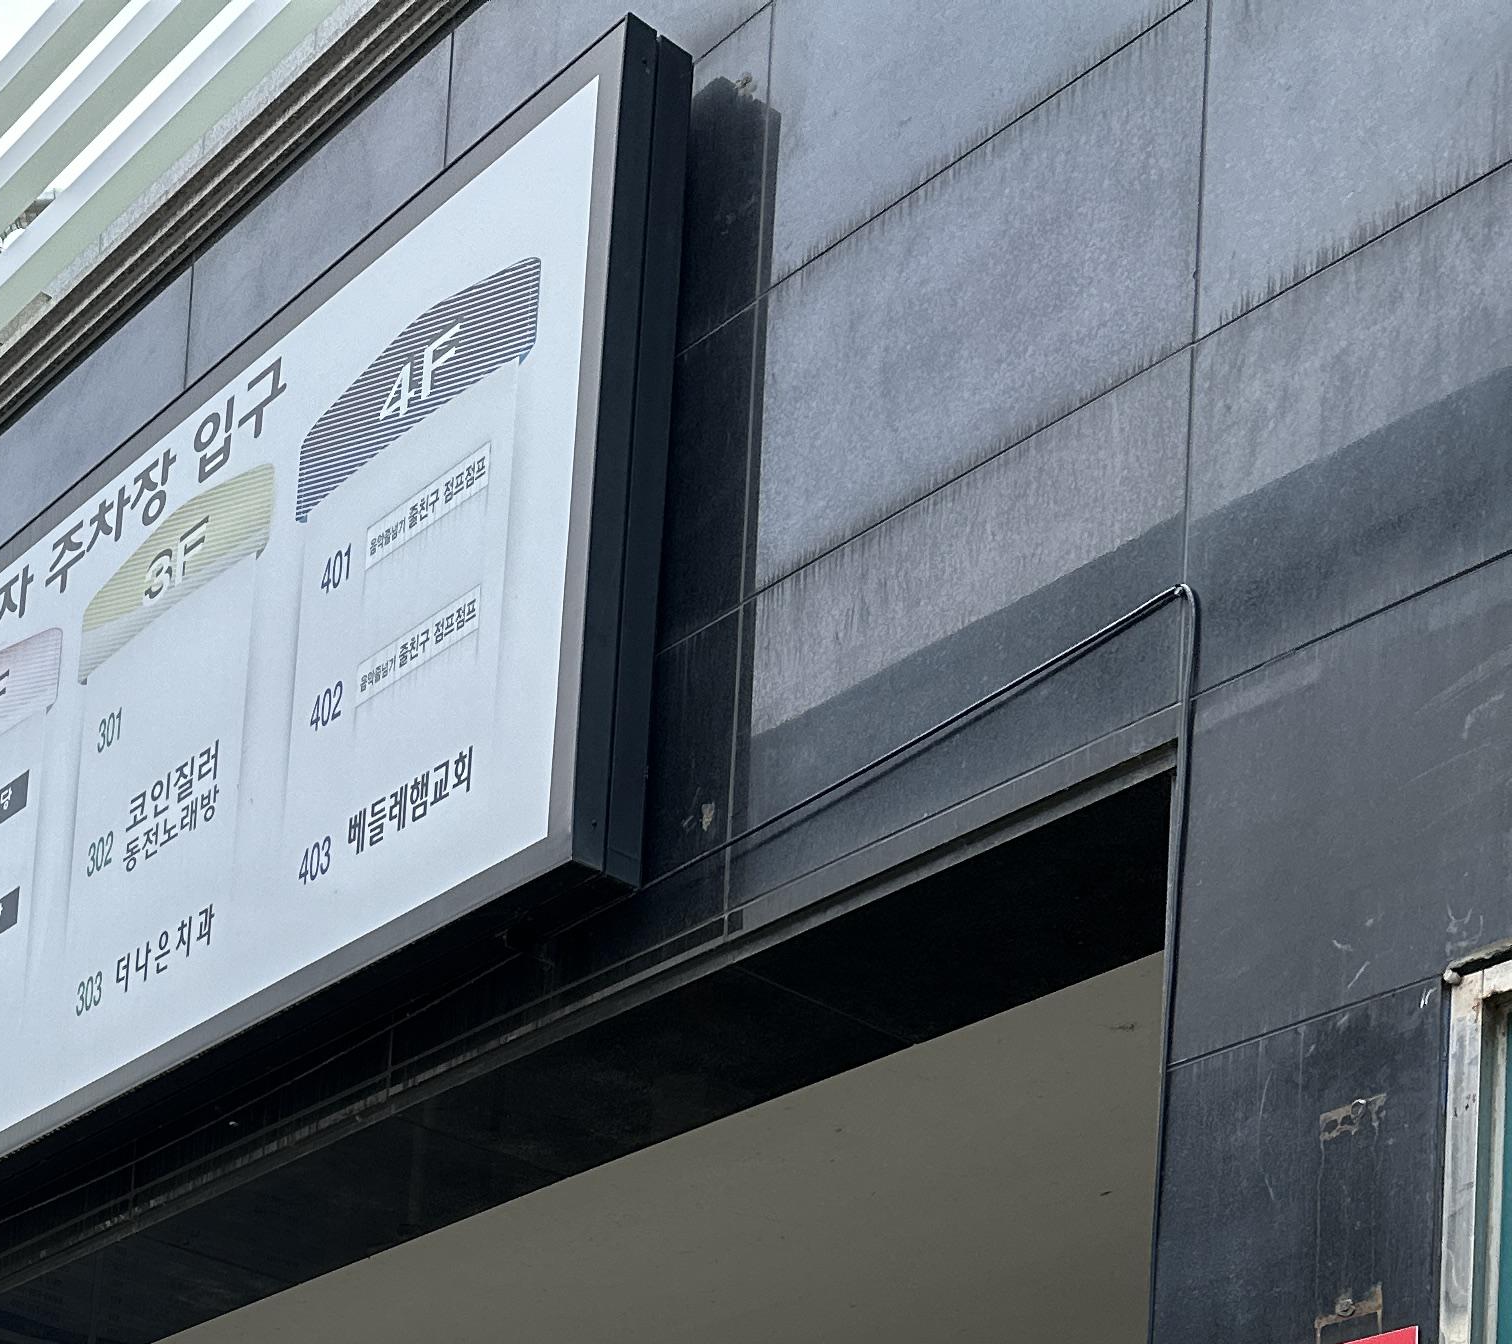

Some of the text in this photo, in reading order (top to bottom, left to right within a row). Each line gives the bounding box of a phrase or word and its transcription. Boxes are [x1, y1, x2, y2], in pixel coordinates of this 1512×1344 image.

[379, 315, 464, 421] 4F
[45, 448, 176, 594] 주차장
[193, 356, 287, 484] 입구
[321, 543, 351, 594] 401
[443, 456, 486, 504] 점프점프
[142, 515, 210, 607] 3F
[310, 680, 343, 731] 402
[434, 598, 476, 645] 점프점프
[97, 706, 122, 753] 301
[87, 784, 220, 877] 302 동전노래방
[125, 739, 220, 833] 코인질러
[299, 835, 331, 885] 403
[76, 903, 215, 1016] 303 더나은치과
